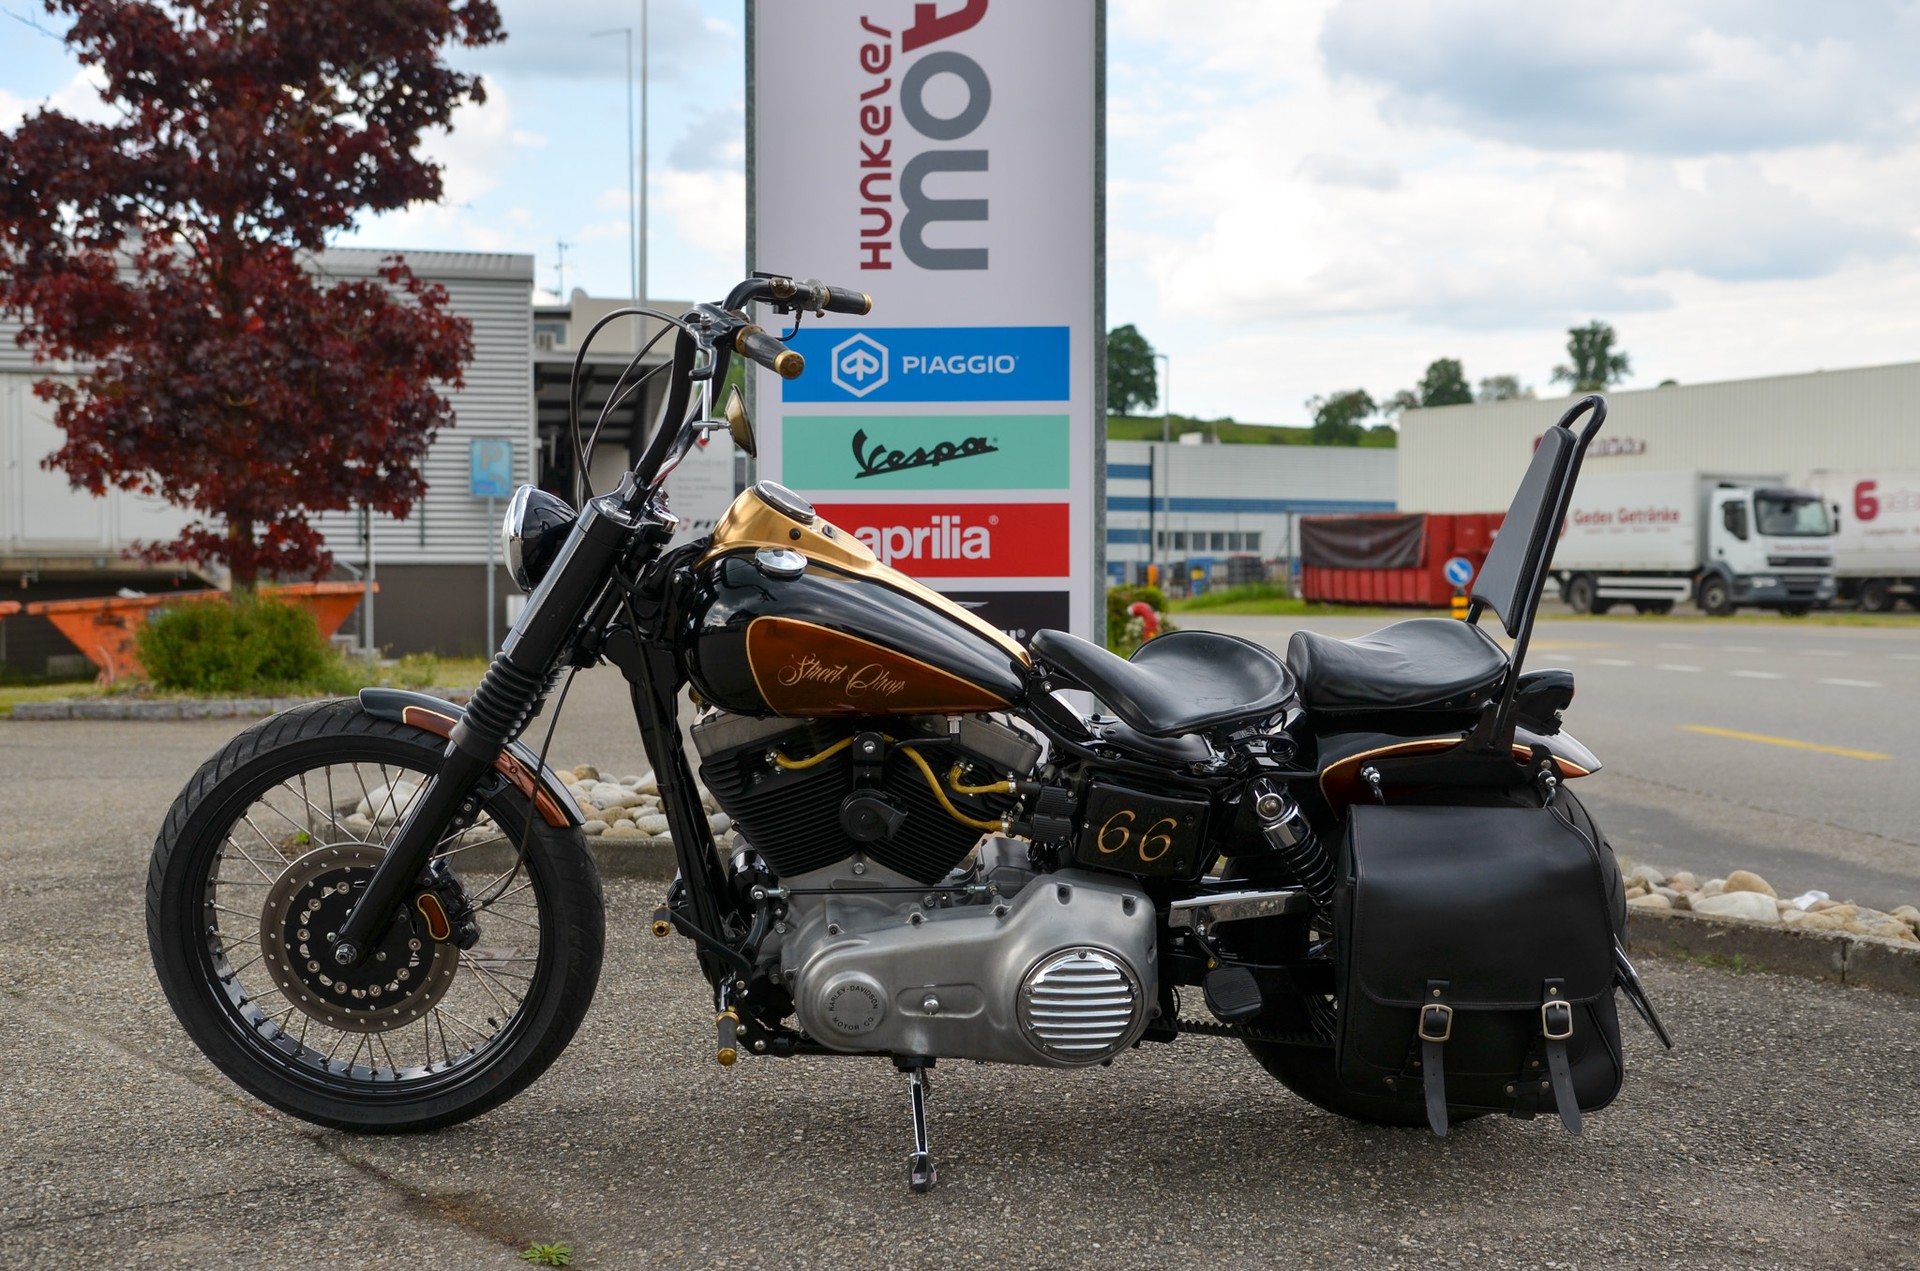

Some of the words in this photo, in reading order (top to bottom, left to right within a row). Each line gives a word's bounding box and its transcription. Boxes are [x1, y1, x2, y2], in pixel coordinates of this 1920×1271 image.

[902, 355, 1016, 375] PIAGGIO
[482, 446, 503, 471] P
[852, 428, 1000, 479] Vespa
[854, 515, 991, 567] aprilia
[828, 985, 878, 1012] HARLEY-DAVIDSON
[832, 1016, 859, 1031] MOTOR
